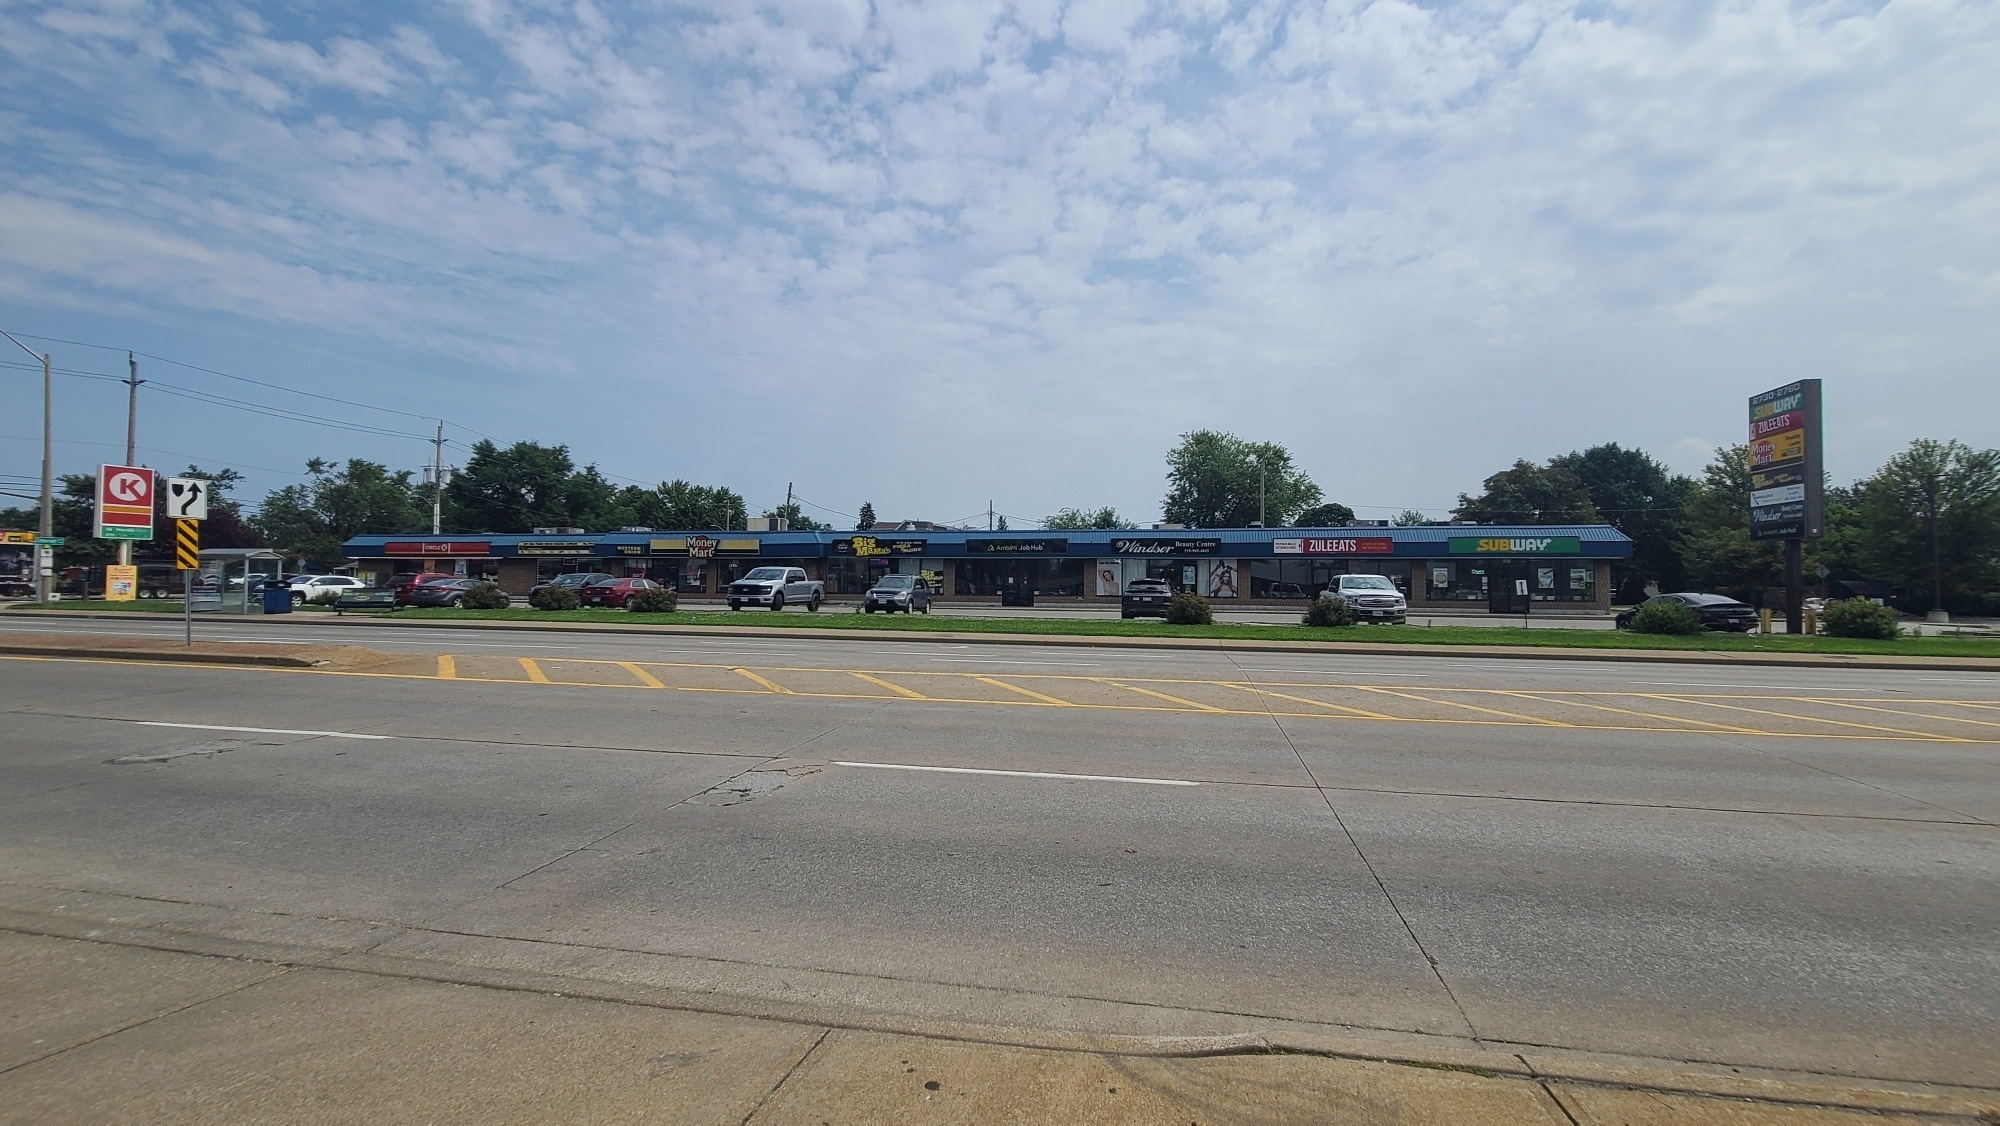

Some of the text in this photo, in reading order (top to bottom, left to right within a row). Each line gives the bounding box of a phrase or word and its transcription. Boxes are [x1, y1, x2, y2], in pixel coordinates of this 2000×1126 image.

[1753, 393, 1801, 420] SUBWAY
[1758, 414, 1790, 433] ZULEEATS
[1752, 442, 1776, 455] Money
[1753, 453, 1773, 466] Mart
[686, 537, 718, 551] Money
[853, 537, 875, 548] Big
[1116, 540, 1175, 553] Windsor
[1309, 539, 1357, 552] ZULEEATS
[1477, 538, 1552, 552] SUBWAY
[689, 547, 715, 557] Mart
